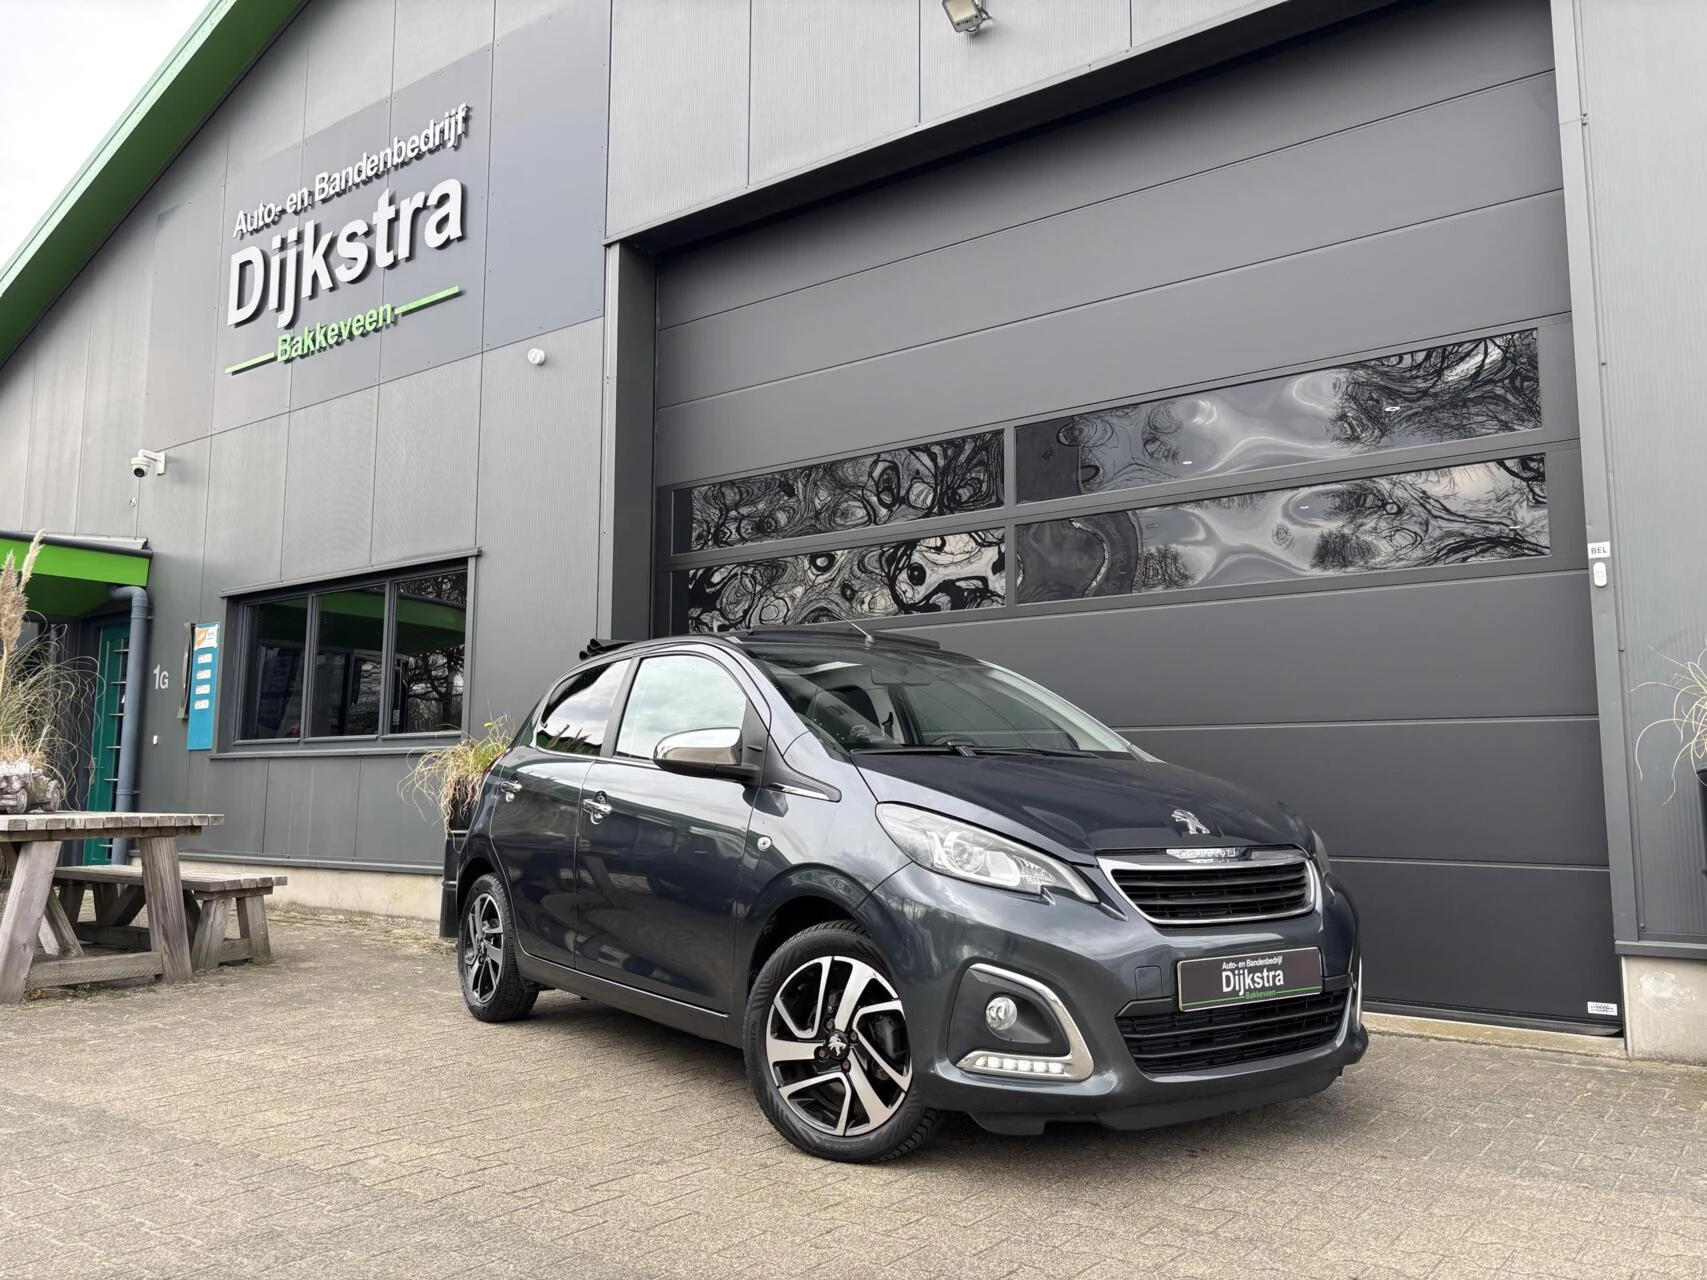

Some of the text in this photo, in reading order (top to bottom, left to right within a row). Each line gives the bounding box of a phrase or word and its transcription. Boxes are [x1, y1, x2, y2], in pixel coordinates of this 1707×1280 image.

[232, 102, 468, 239] Auto- en Bandenbedrijf
[227, 178, 463, 328] Dijkstra
[276, 303, 393, 362] Bakkeveen
[1591, 546, 1608, 555] BEL
[153, 664, 169, 690] 1G
[1222, 961, 1238, 969] Auto-
[1246, 955, 1283, 967] Bandenbedrijf
[1221, 967, 1285, 997] Dijkstra
